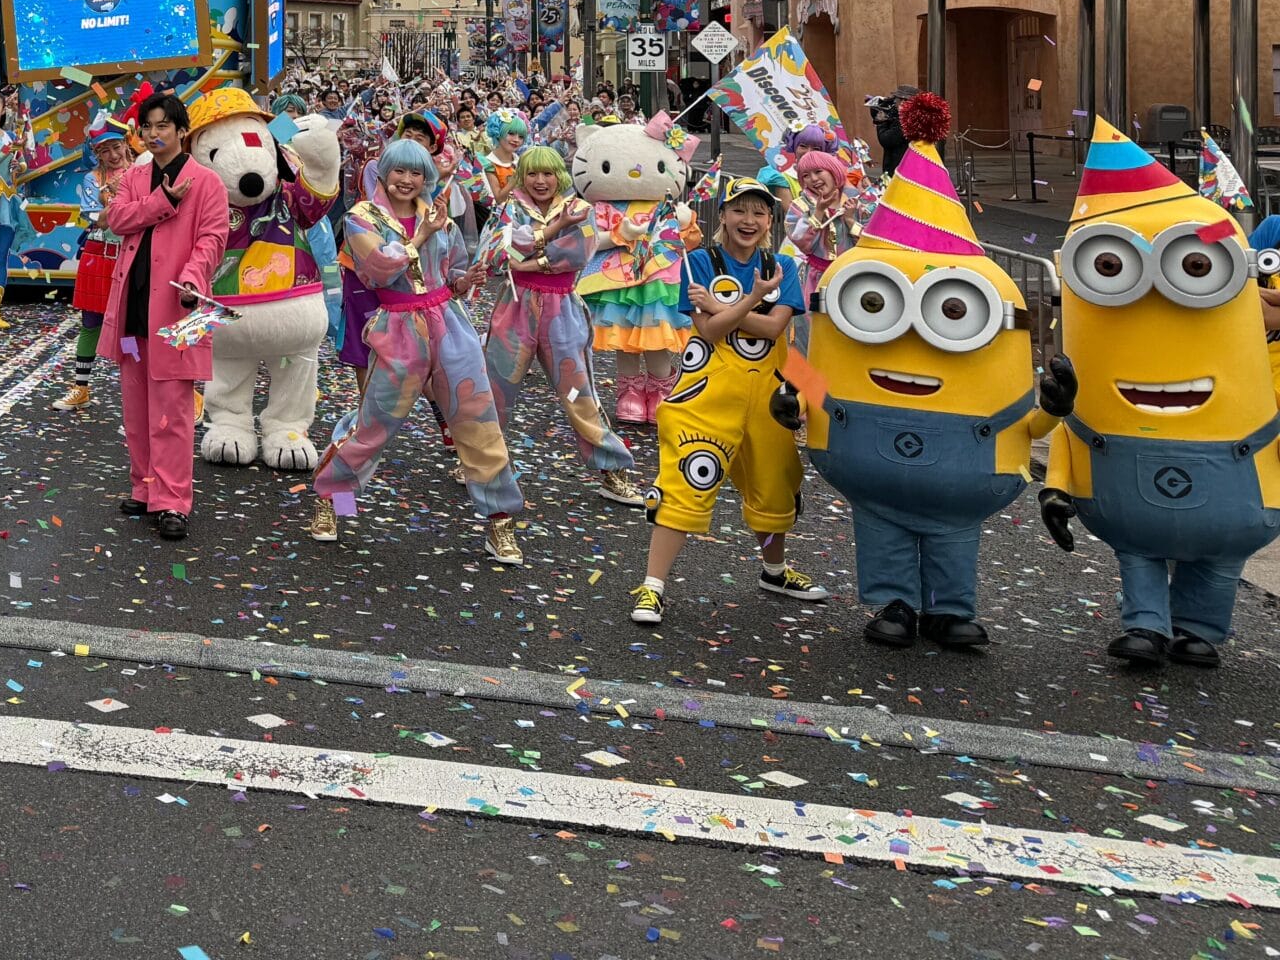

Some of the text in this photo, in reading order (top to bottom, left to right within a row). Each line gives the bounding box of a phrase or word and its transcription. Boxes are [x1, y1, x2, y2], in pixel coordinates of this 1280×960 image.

[81, 15, 130, 29] NO LIMIT!
[631, 38, 664, 57] 35
[746, 66, 800, 123] Discove
